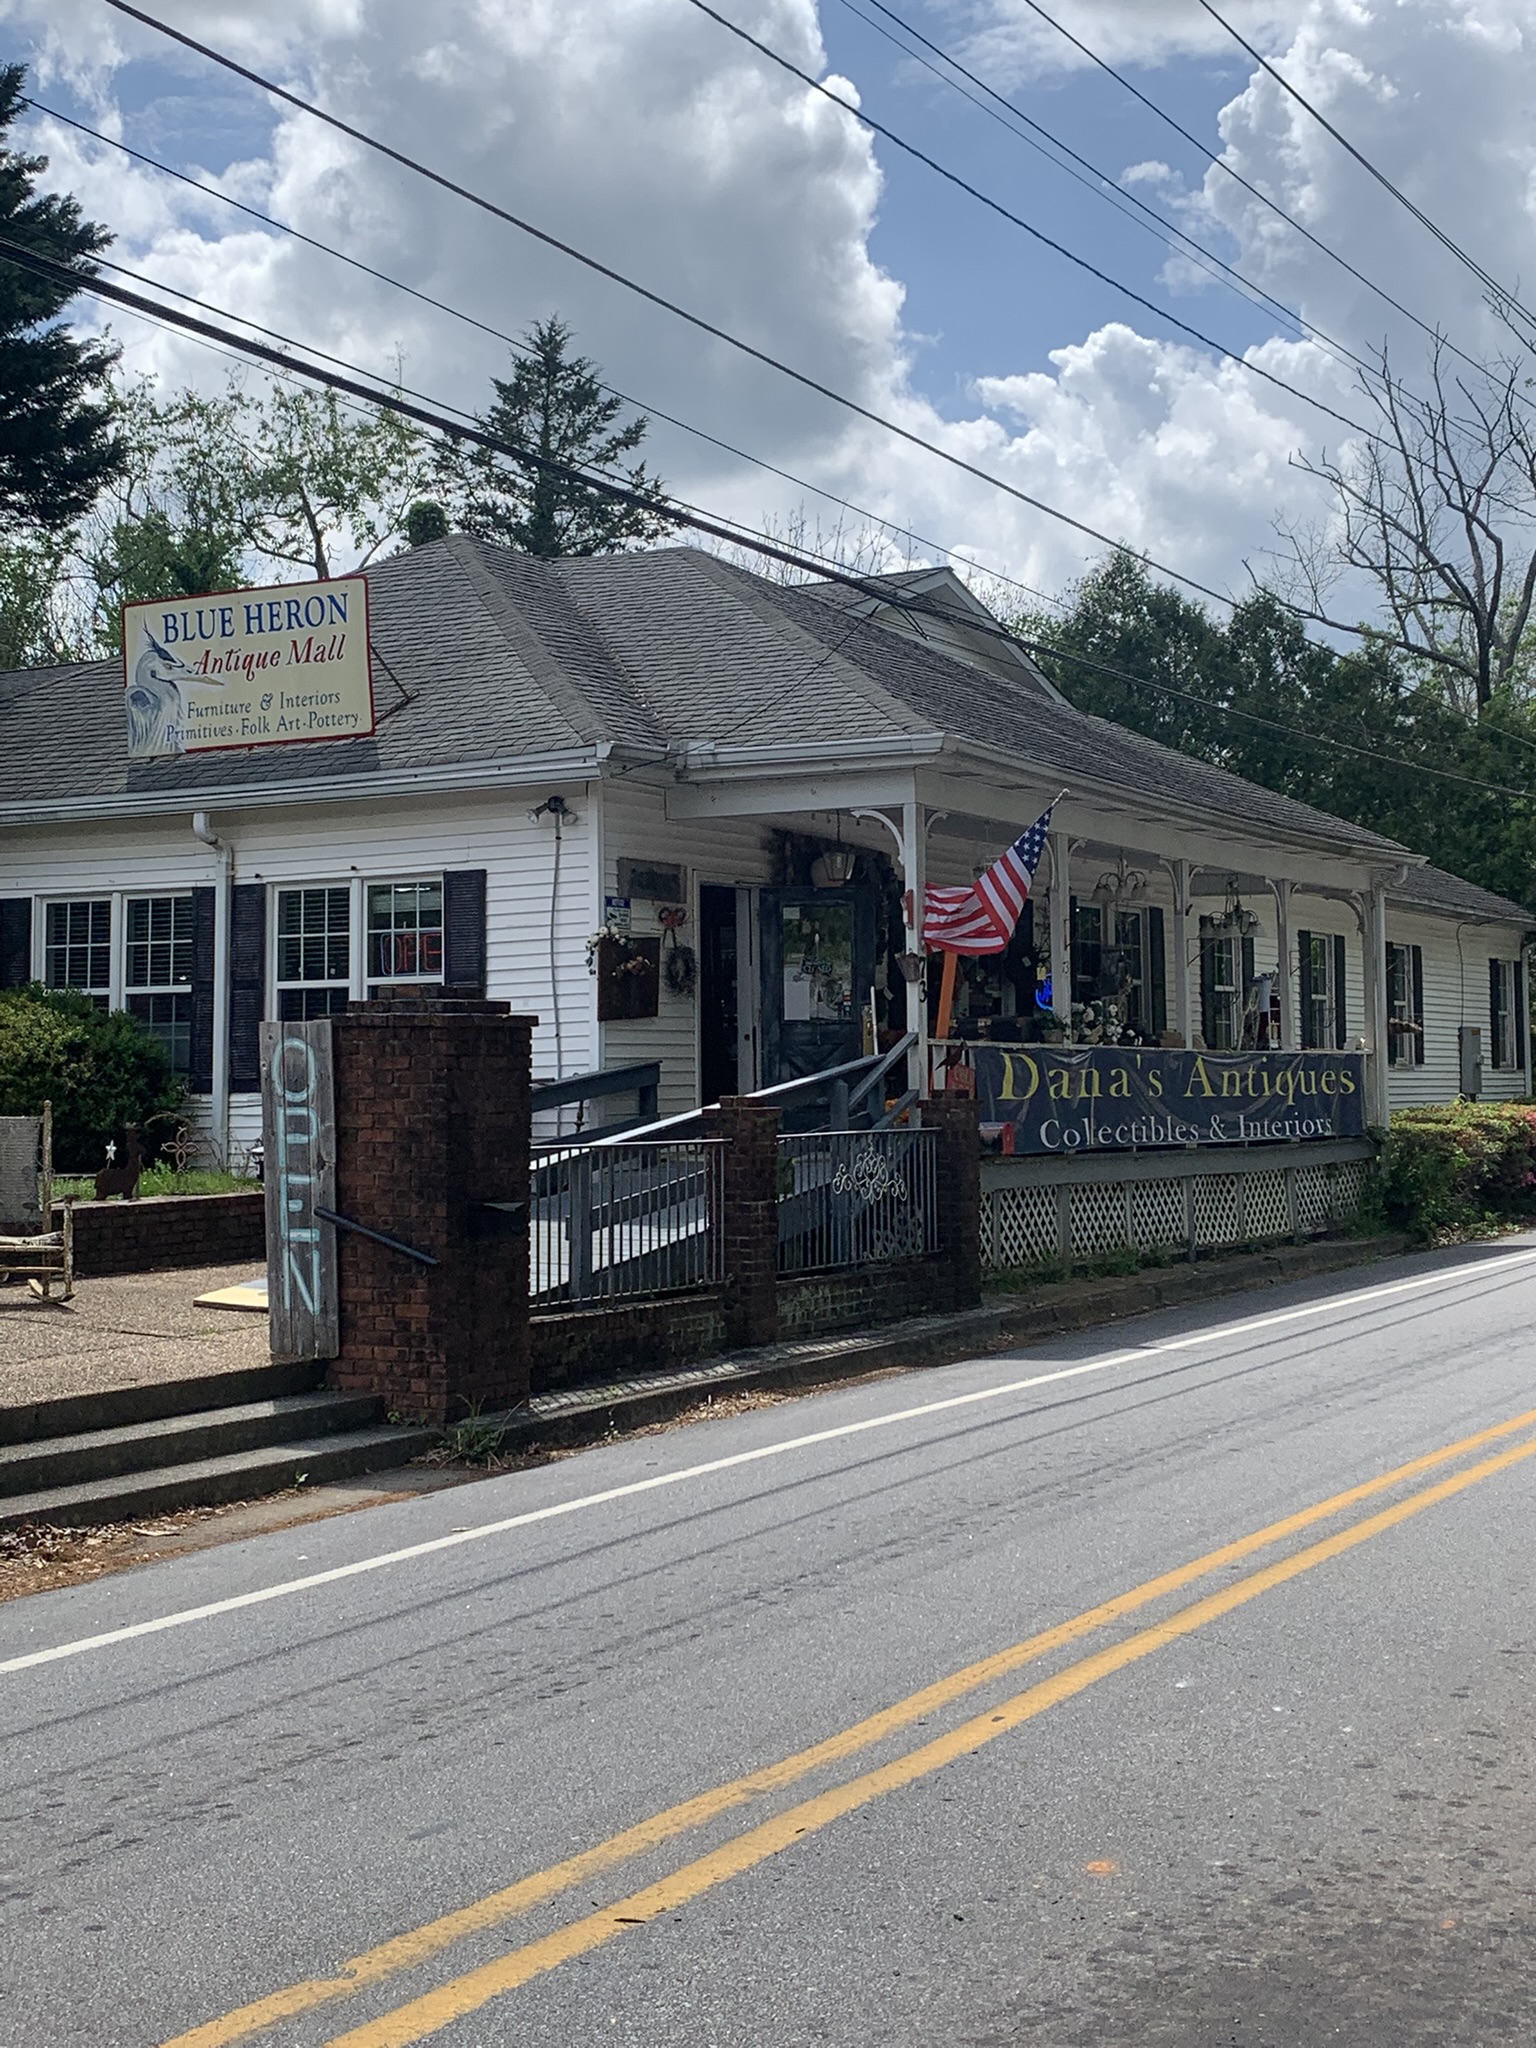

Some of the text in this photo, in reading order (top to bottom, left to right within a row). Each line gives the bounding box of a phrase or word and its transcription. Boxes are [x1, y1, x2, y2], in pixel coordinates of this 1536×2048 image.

[161, 592, 349, 644] BLUE HERON
[193, 633, 346, 682] Antique Mall
[166, 723, 233, 742] Primitives
[241, 715, 271, 736] Folk
[276, 714, 301, 733] Art
[187, 690, 341, 719] Furniture & Interiors
[996, 1051, 1357, 1107] Dana's Antiques
[1209, 1114, 1228, 1140] &
[1237, 1111, 1333, 1139] Interiors
[271, 1036, 321, 1317] OPEN
